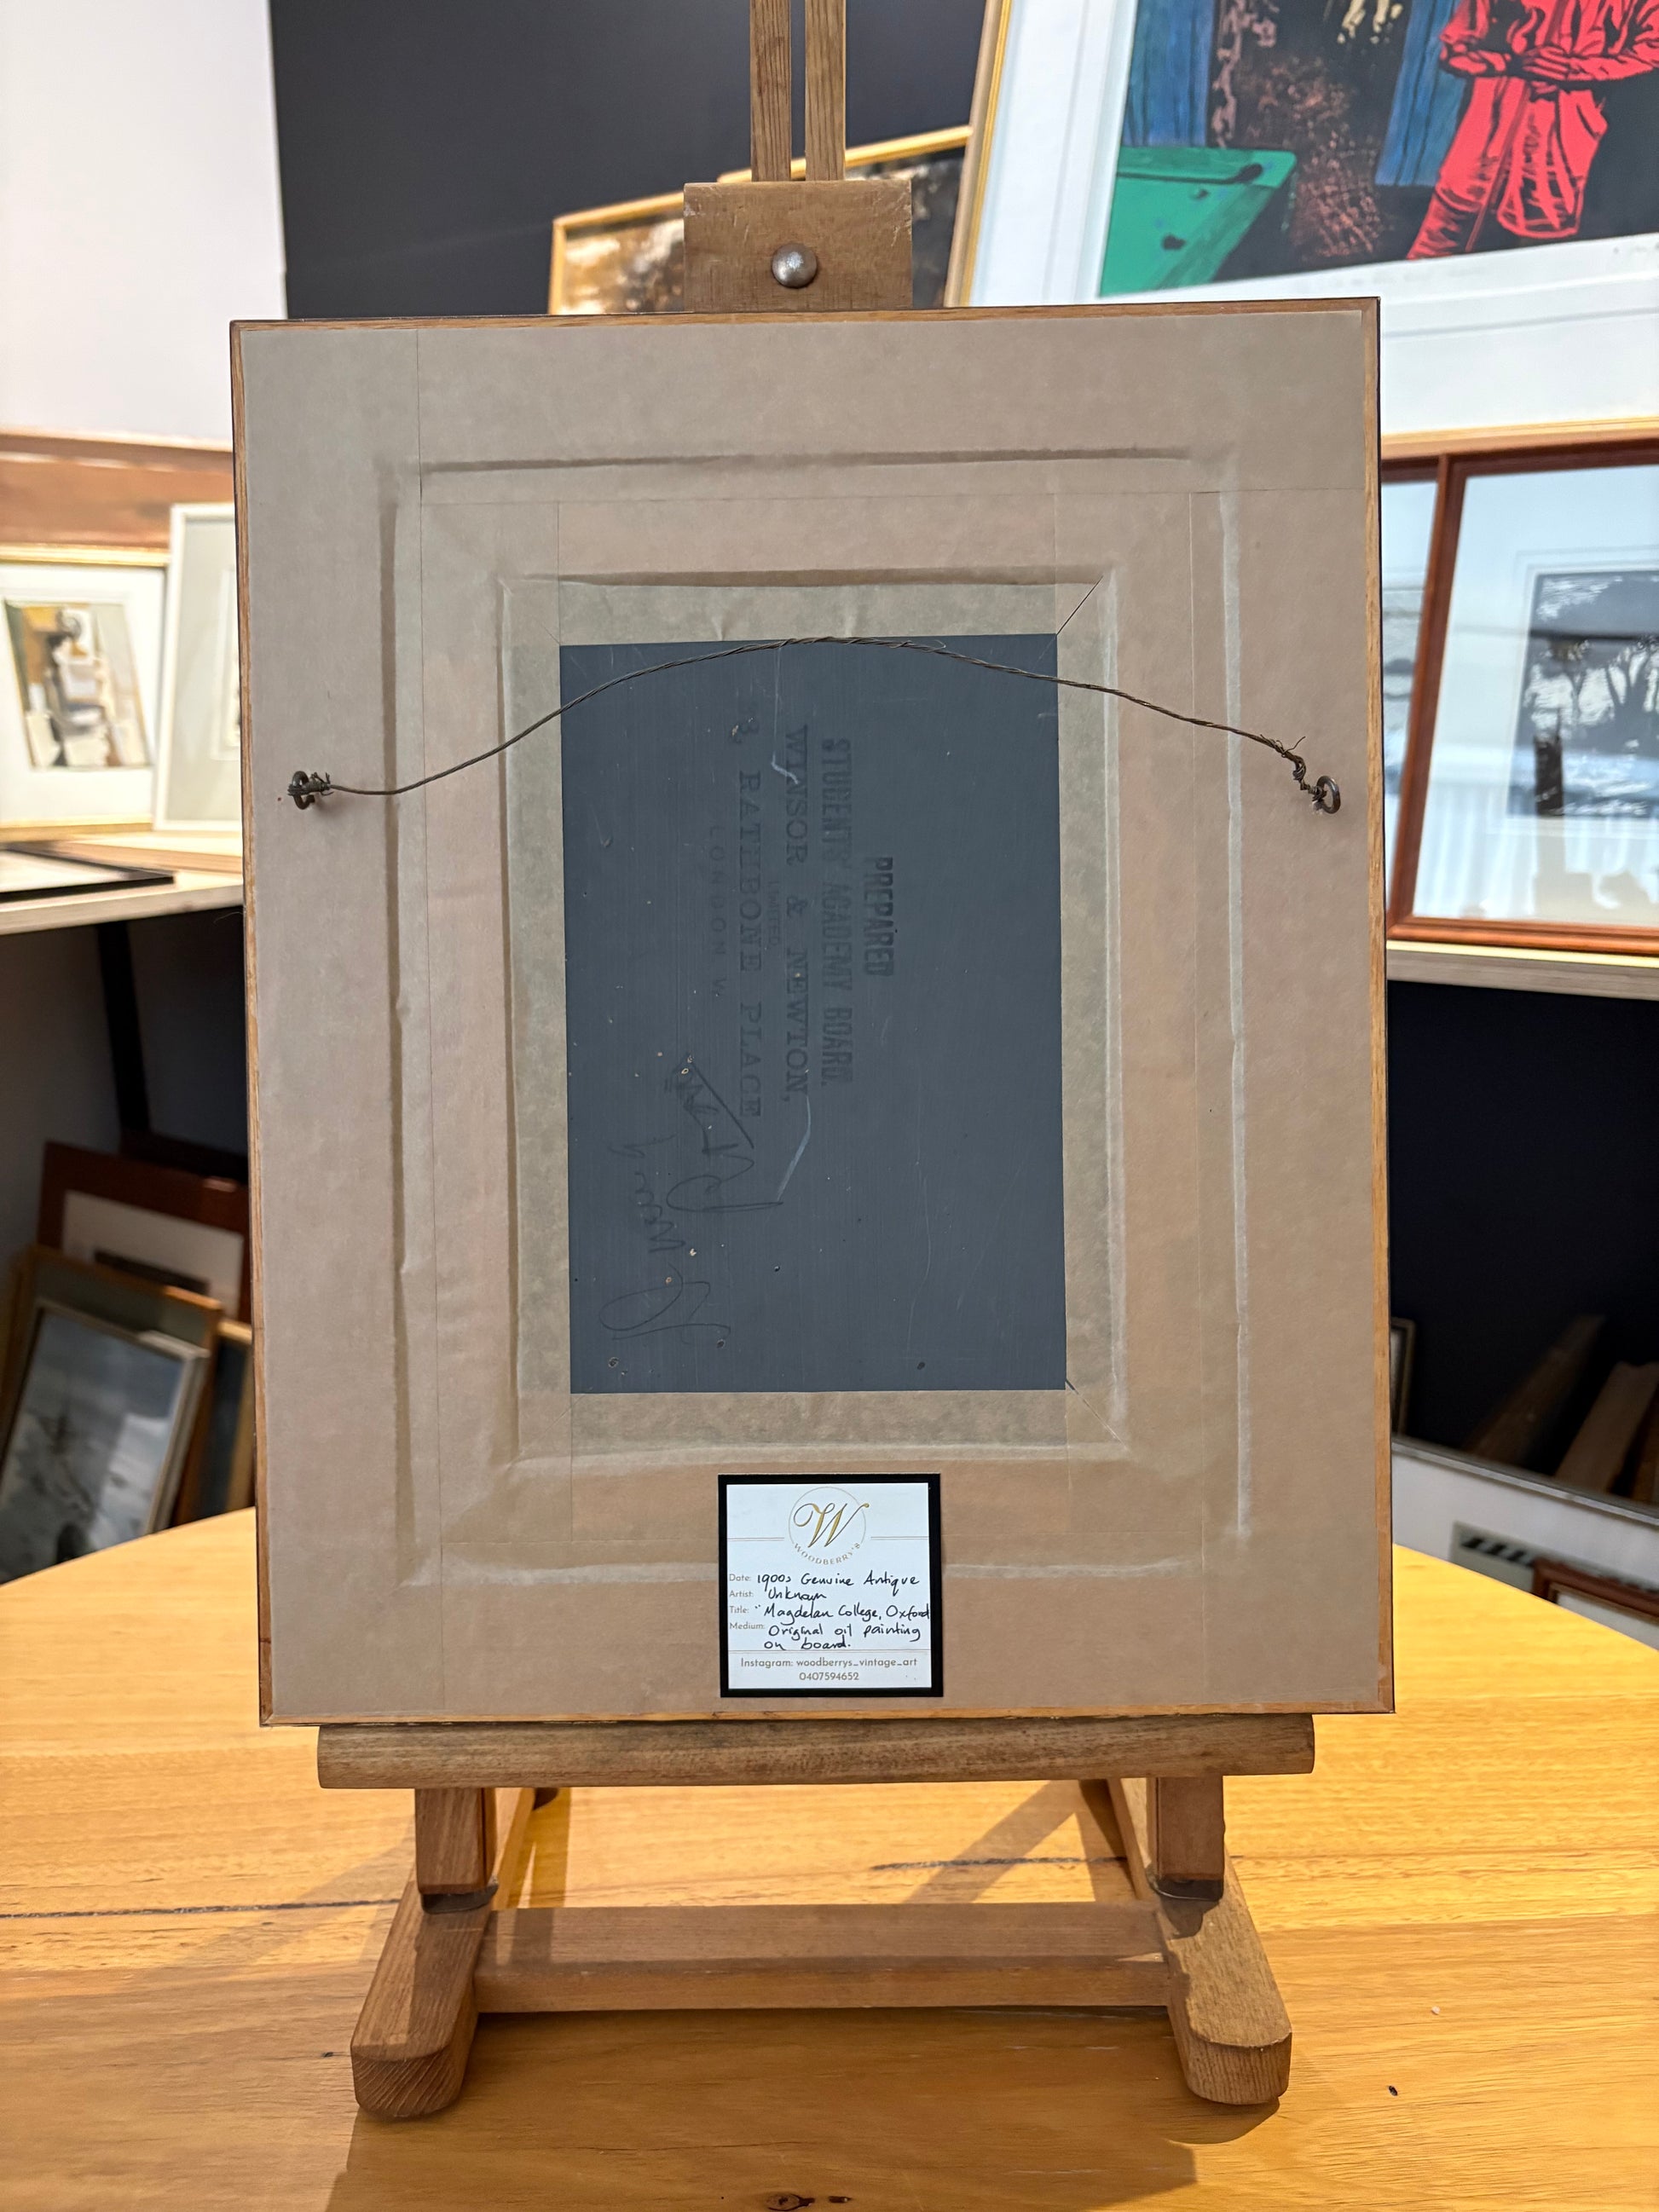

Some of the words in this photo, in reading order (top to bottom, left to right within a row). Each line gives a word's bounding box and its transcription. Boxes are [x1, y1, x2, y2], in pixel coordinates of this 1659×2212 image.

[784, 724, 808, 866] WINSOR
[738, 770, 761, 973] RATHBONE
[708, 825, 728, 956] LONDON
[785, 893, 808, 919] &
[863, 856, 894, 977] PREPARED
[821, 882, 853, 991] ACADEMY
[757, 1574, 792, 1592] 1900s
[801, 1573, 854, 1586] Genuine
[863, 1569, 920, 1597] Antique
[730, 1605, 749, 1614] Title:
[886, 1603, 930, 1621] Oxford
[729, 1621, 765, 1630] Medium:
[768, 1623, 824, 1641] Original
[863, 1622, 921, 1643] painting
[764, 1641, 787, 1651] on
[740, 1658, 794, 1668] Instagram:
[796, 1657, 917, 1668] woodberrys_vintage_art
[799, 1672, 860, 1681] 0407594652
